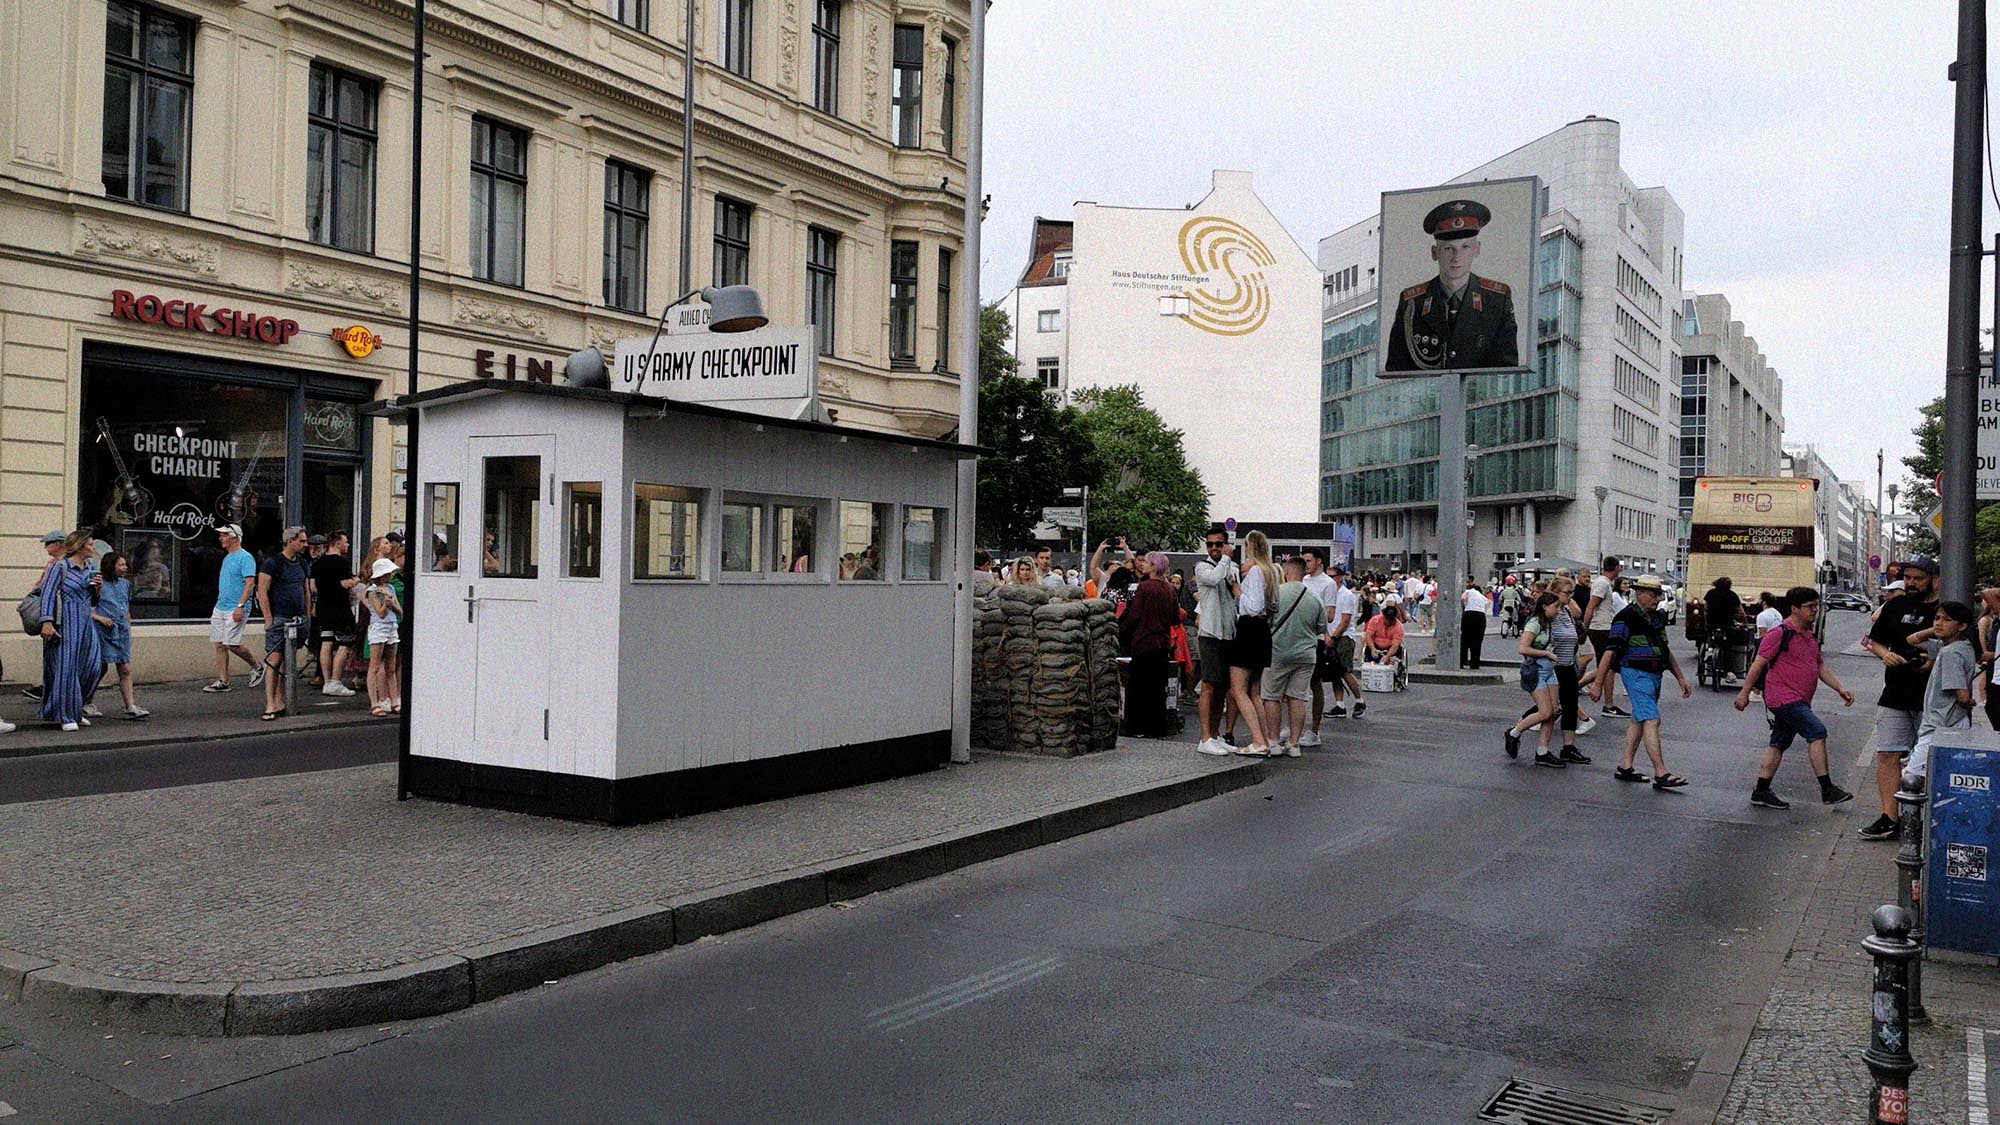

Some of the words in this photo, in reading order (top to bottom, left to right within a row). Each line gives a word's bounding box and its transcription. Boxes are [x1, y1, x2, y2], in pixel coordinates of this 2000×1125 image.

[1112, 270, 1131, 278] Haus
[1132, 271, 1169, 280] Deutscher
[1171, 274, 1210, 283] Stiftungen
[112, 289, 209, 332] ROCK
[212, 307, 300, 345] SHOP
[678, 309, 701, 327] ALLIED
[652, 351, 696, 382] ARMY
[701, 344, 799, 380] CHECKPOINT
[133, 432, 239, 459] CHECKPOINT
[151, 455, 222, 479] CHARLIE
[1733, 493, 1755, 502] BIG
[153, 510, 185, 525] Hard
[186, 511, 216, 529] Rock
[1749, 528, 1794, 536] DISCOVER
[1953, 775, 1987, 789] DDR
